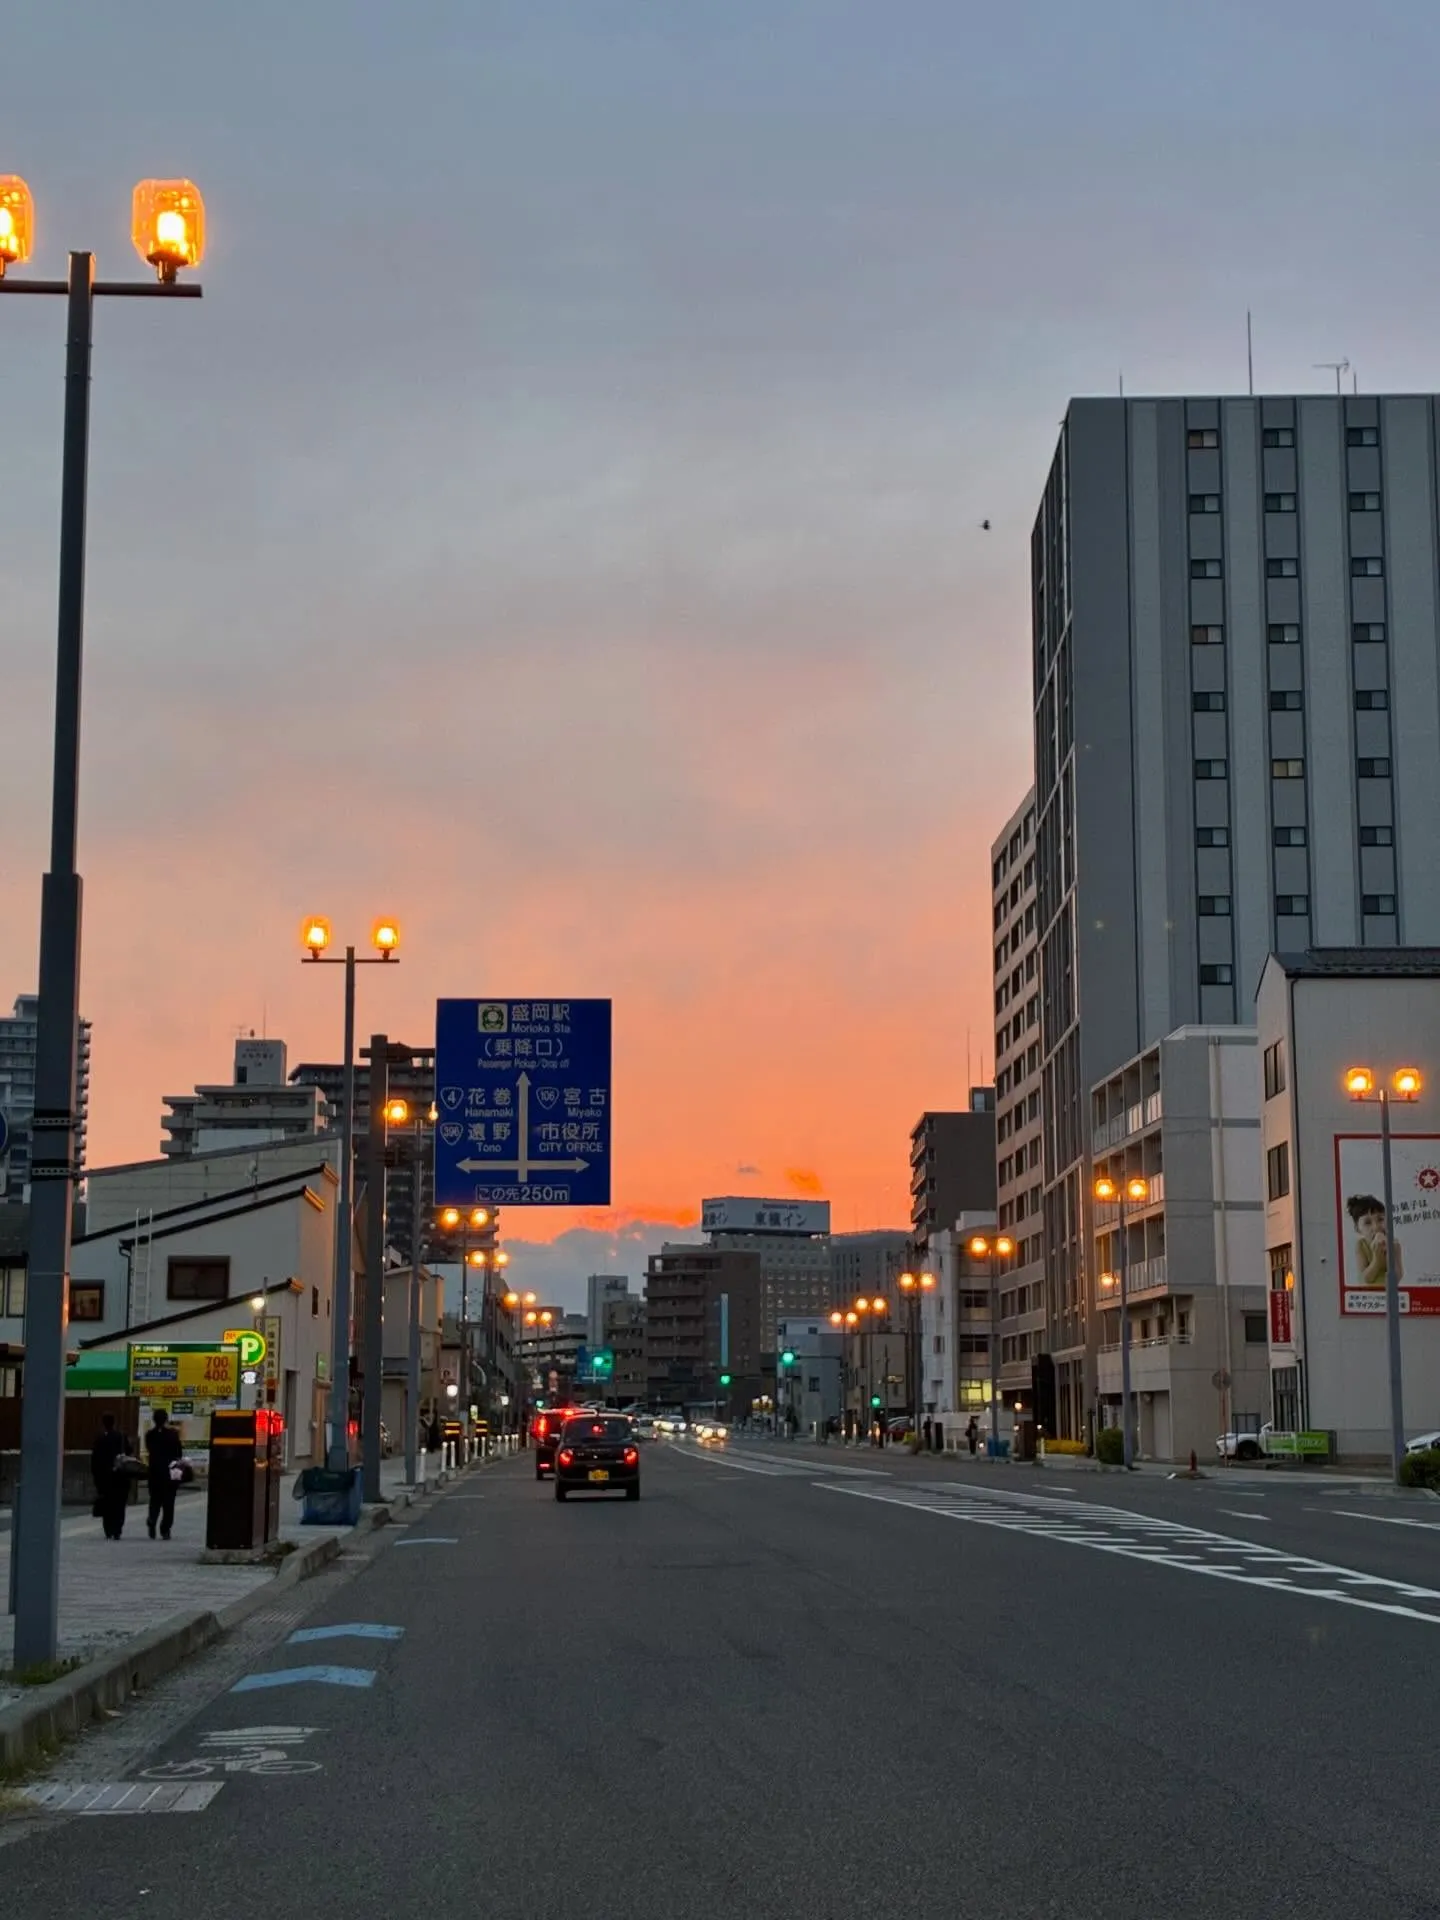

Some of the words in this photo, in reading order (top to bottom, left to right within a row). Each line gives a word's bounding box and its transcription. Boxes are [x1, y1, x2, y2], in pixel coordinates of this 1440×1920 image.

[511, 1003, 571, 1021] 盛岡駅
[511, 1023, 550, 1033] Morioka
[447, 1090, 456, 1104] 4
[467, 1087, 512, 1105] 花巻
[563, 1087, 607, 1105] 宮古
[465, 1107, 514, 1117] Hanamaki
[567, 1107, 602, 1118] Miyako
[467, 1122, 511, 1141] 遠野
[541, 1122, 600, 1141] 市役所
[476, 1142, 502, 1152] Tono
[539, 1142, 562, 1153] CITY
[566, 1142, 603, 1153] OFFICE
[478, 1186, 569, 1201] この先250m
[754, 1210, 808, 1227] 東横イン
[241, 1337, 259, 1361] P
